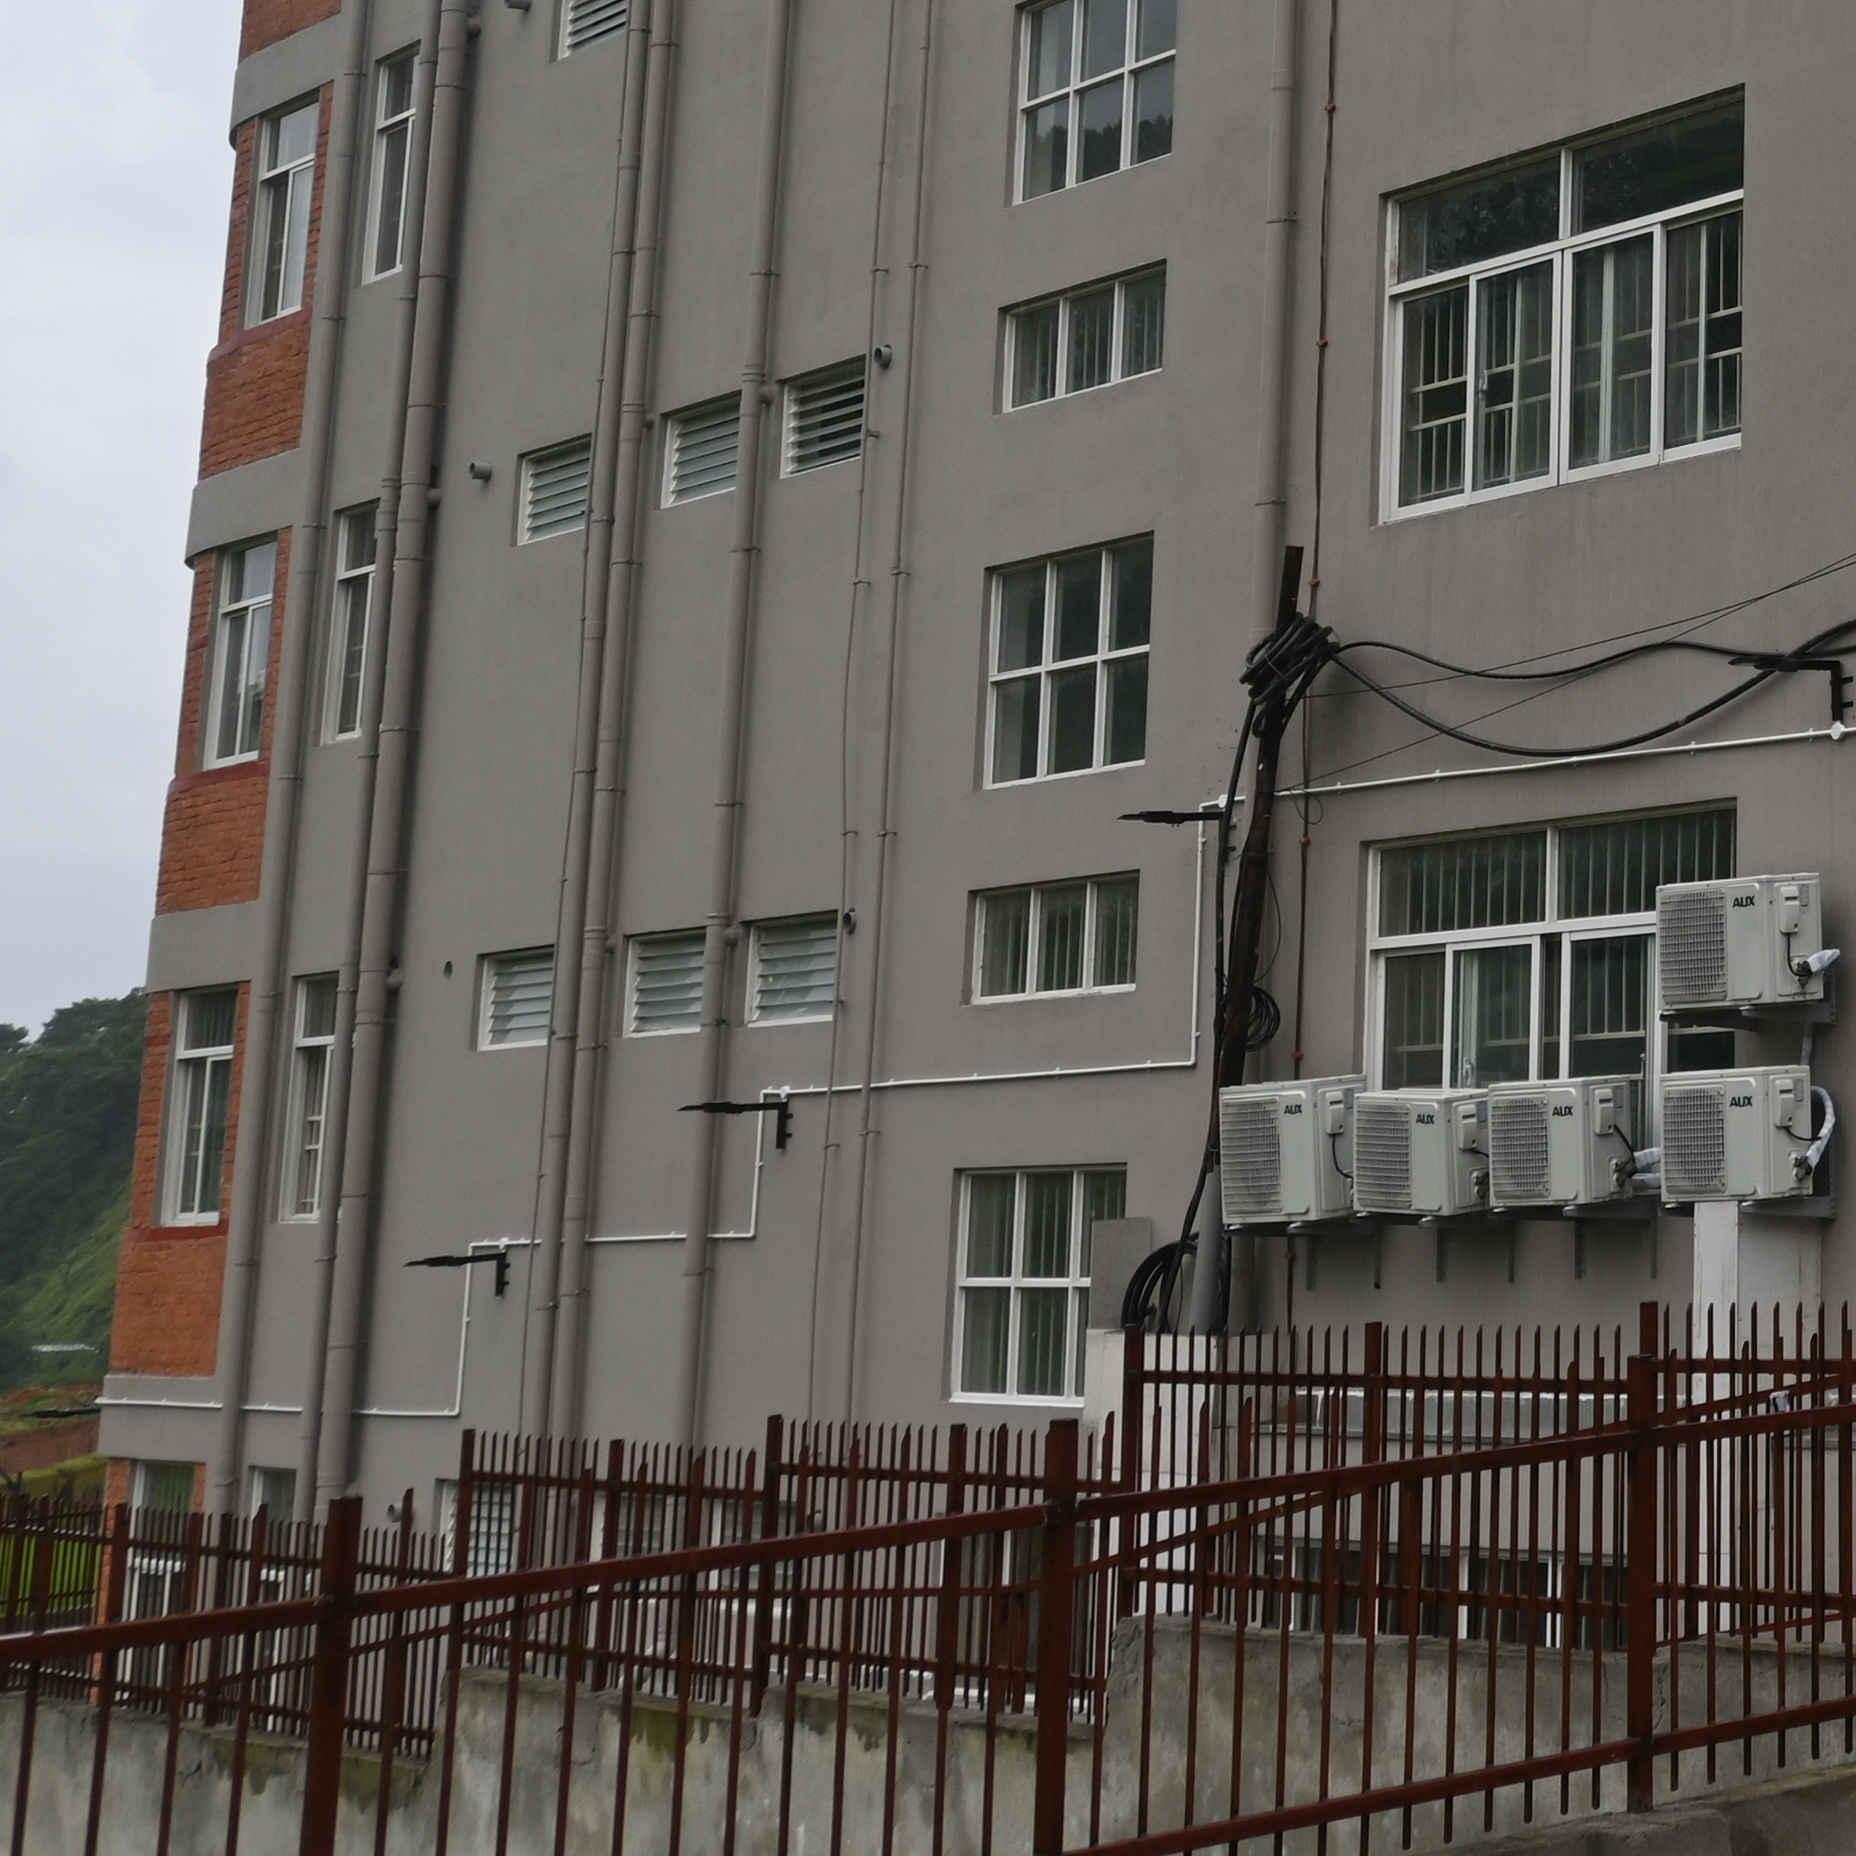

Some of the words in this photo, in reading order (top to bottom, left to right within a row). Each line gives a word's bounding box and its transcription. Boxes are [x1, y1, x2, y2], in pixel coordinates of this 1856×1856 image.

[1733, 895, 1755, 908] AUX
[1730, 1096, 1753, 1108] AUX
[1283, 1104, 1303, 1114] AUX
[1552, 1105, 1574, 1117] AUX
[1416, 1113, 1435, 1124] AUX
